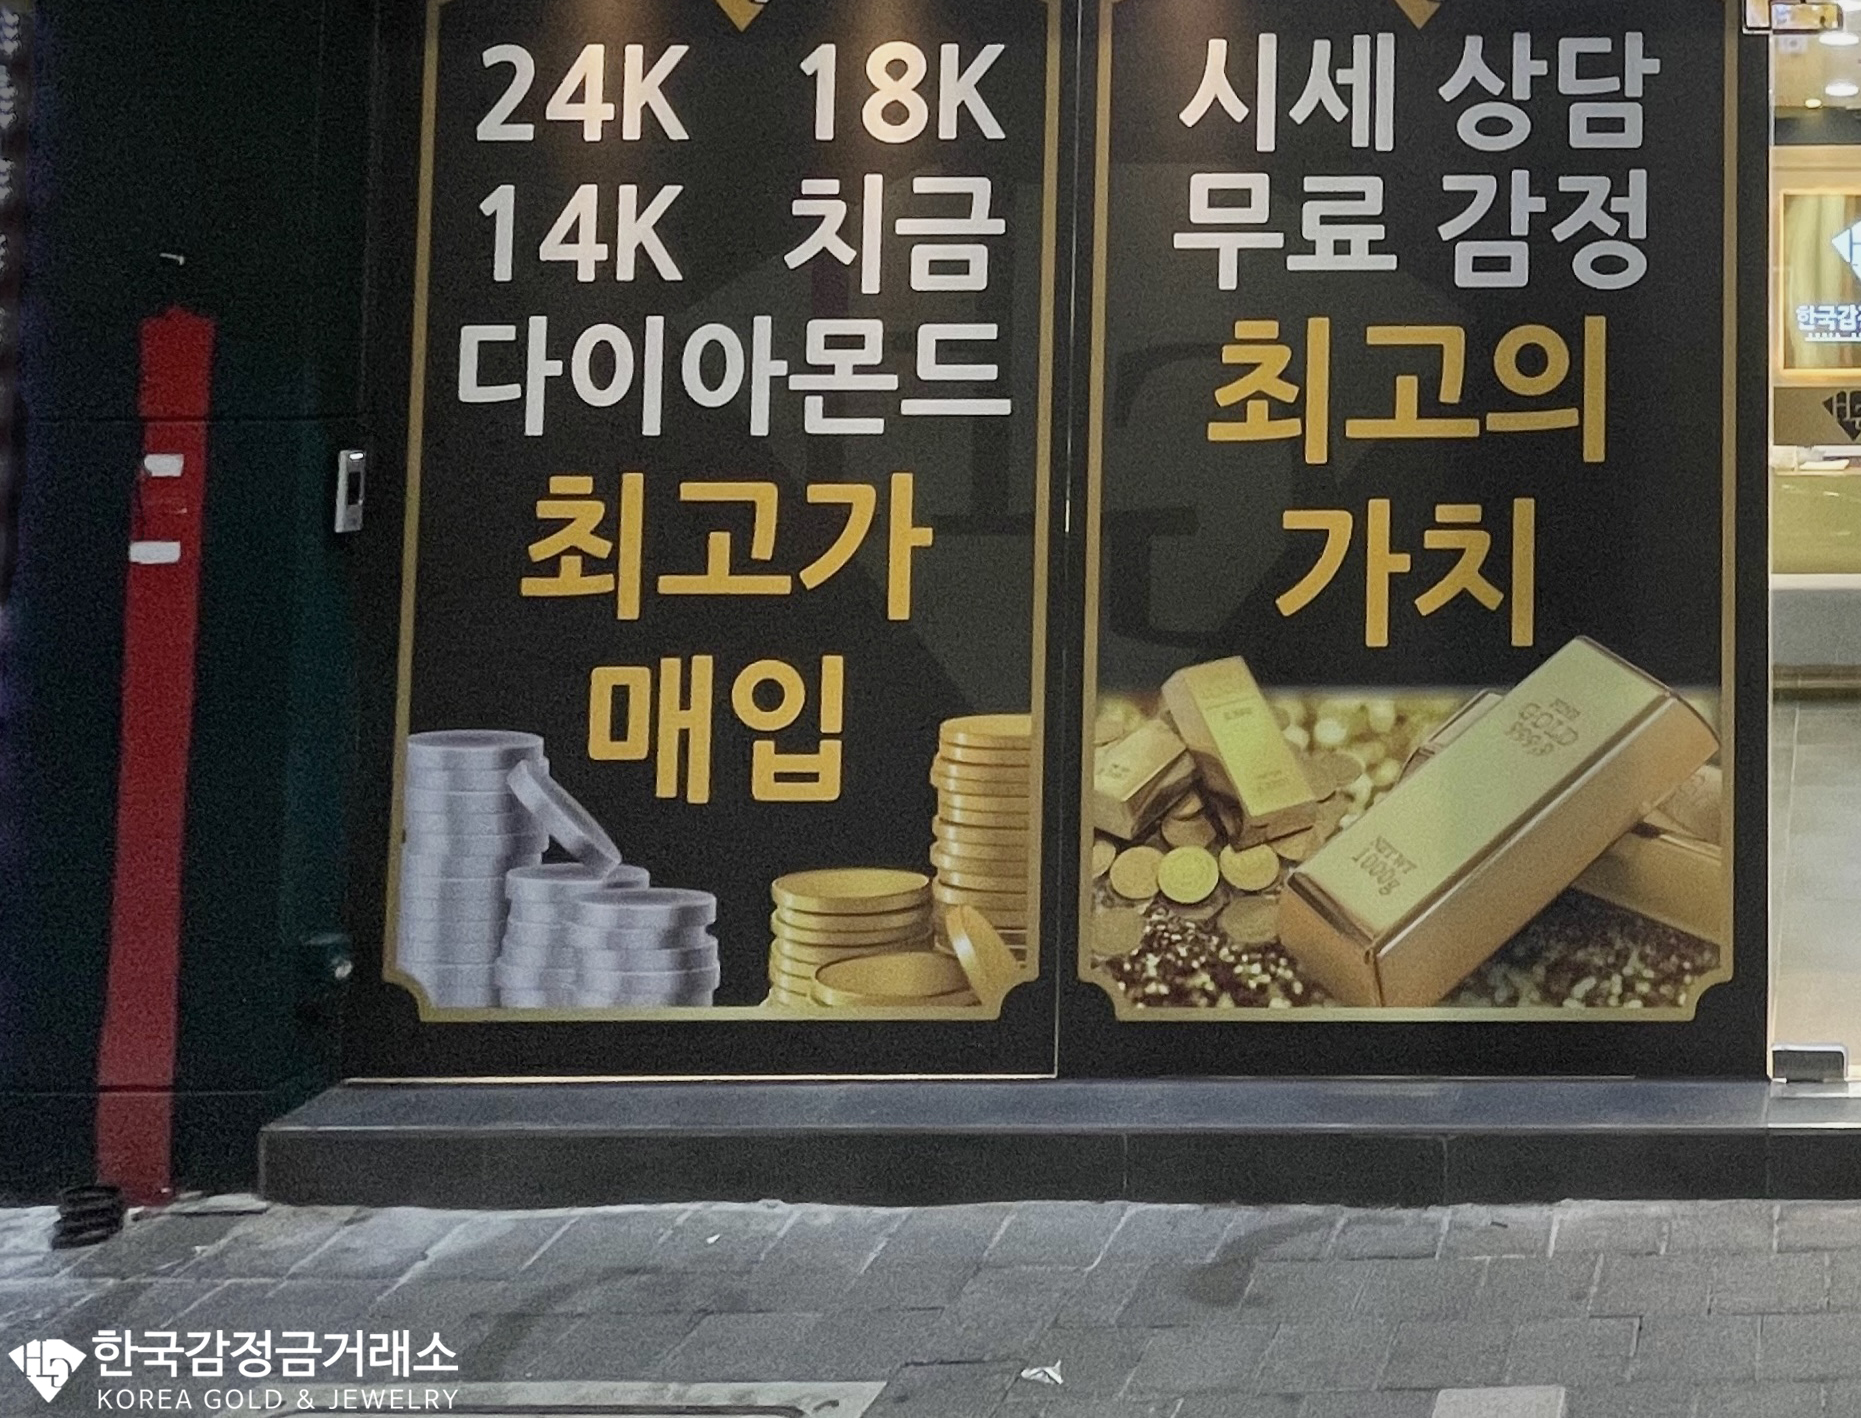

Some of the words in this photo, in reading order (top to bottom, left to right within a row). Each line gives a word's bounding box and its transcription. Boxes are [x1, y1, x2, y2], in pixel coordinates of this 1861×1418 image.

[476, 43, 690, 142] 24K
[800, 41, 1006, 144] 18K
[1179, 32, 1395, 152] 시세
[1438, 32, 1660, 151] 상담
[479, 184, 684, 282] 14K
[784, 174, 1006, 294] 치금
[1173, 172, 1397, 291] 무료
[1437, 168, 1648, 290] 감정
[458, 316, 1011, 437] 다이아몬드
[1207, 315, 1606, 464] 최고의
[521, 472, 933, 620] 최고가
[1275, 498, 1535, 647] 가치
[589, 655, 845, 804] 매입
